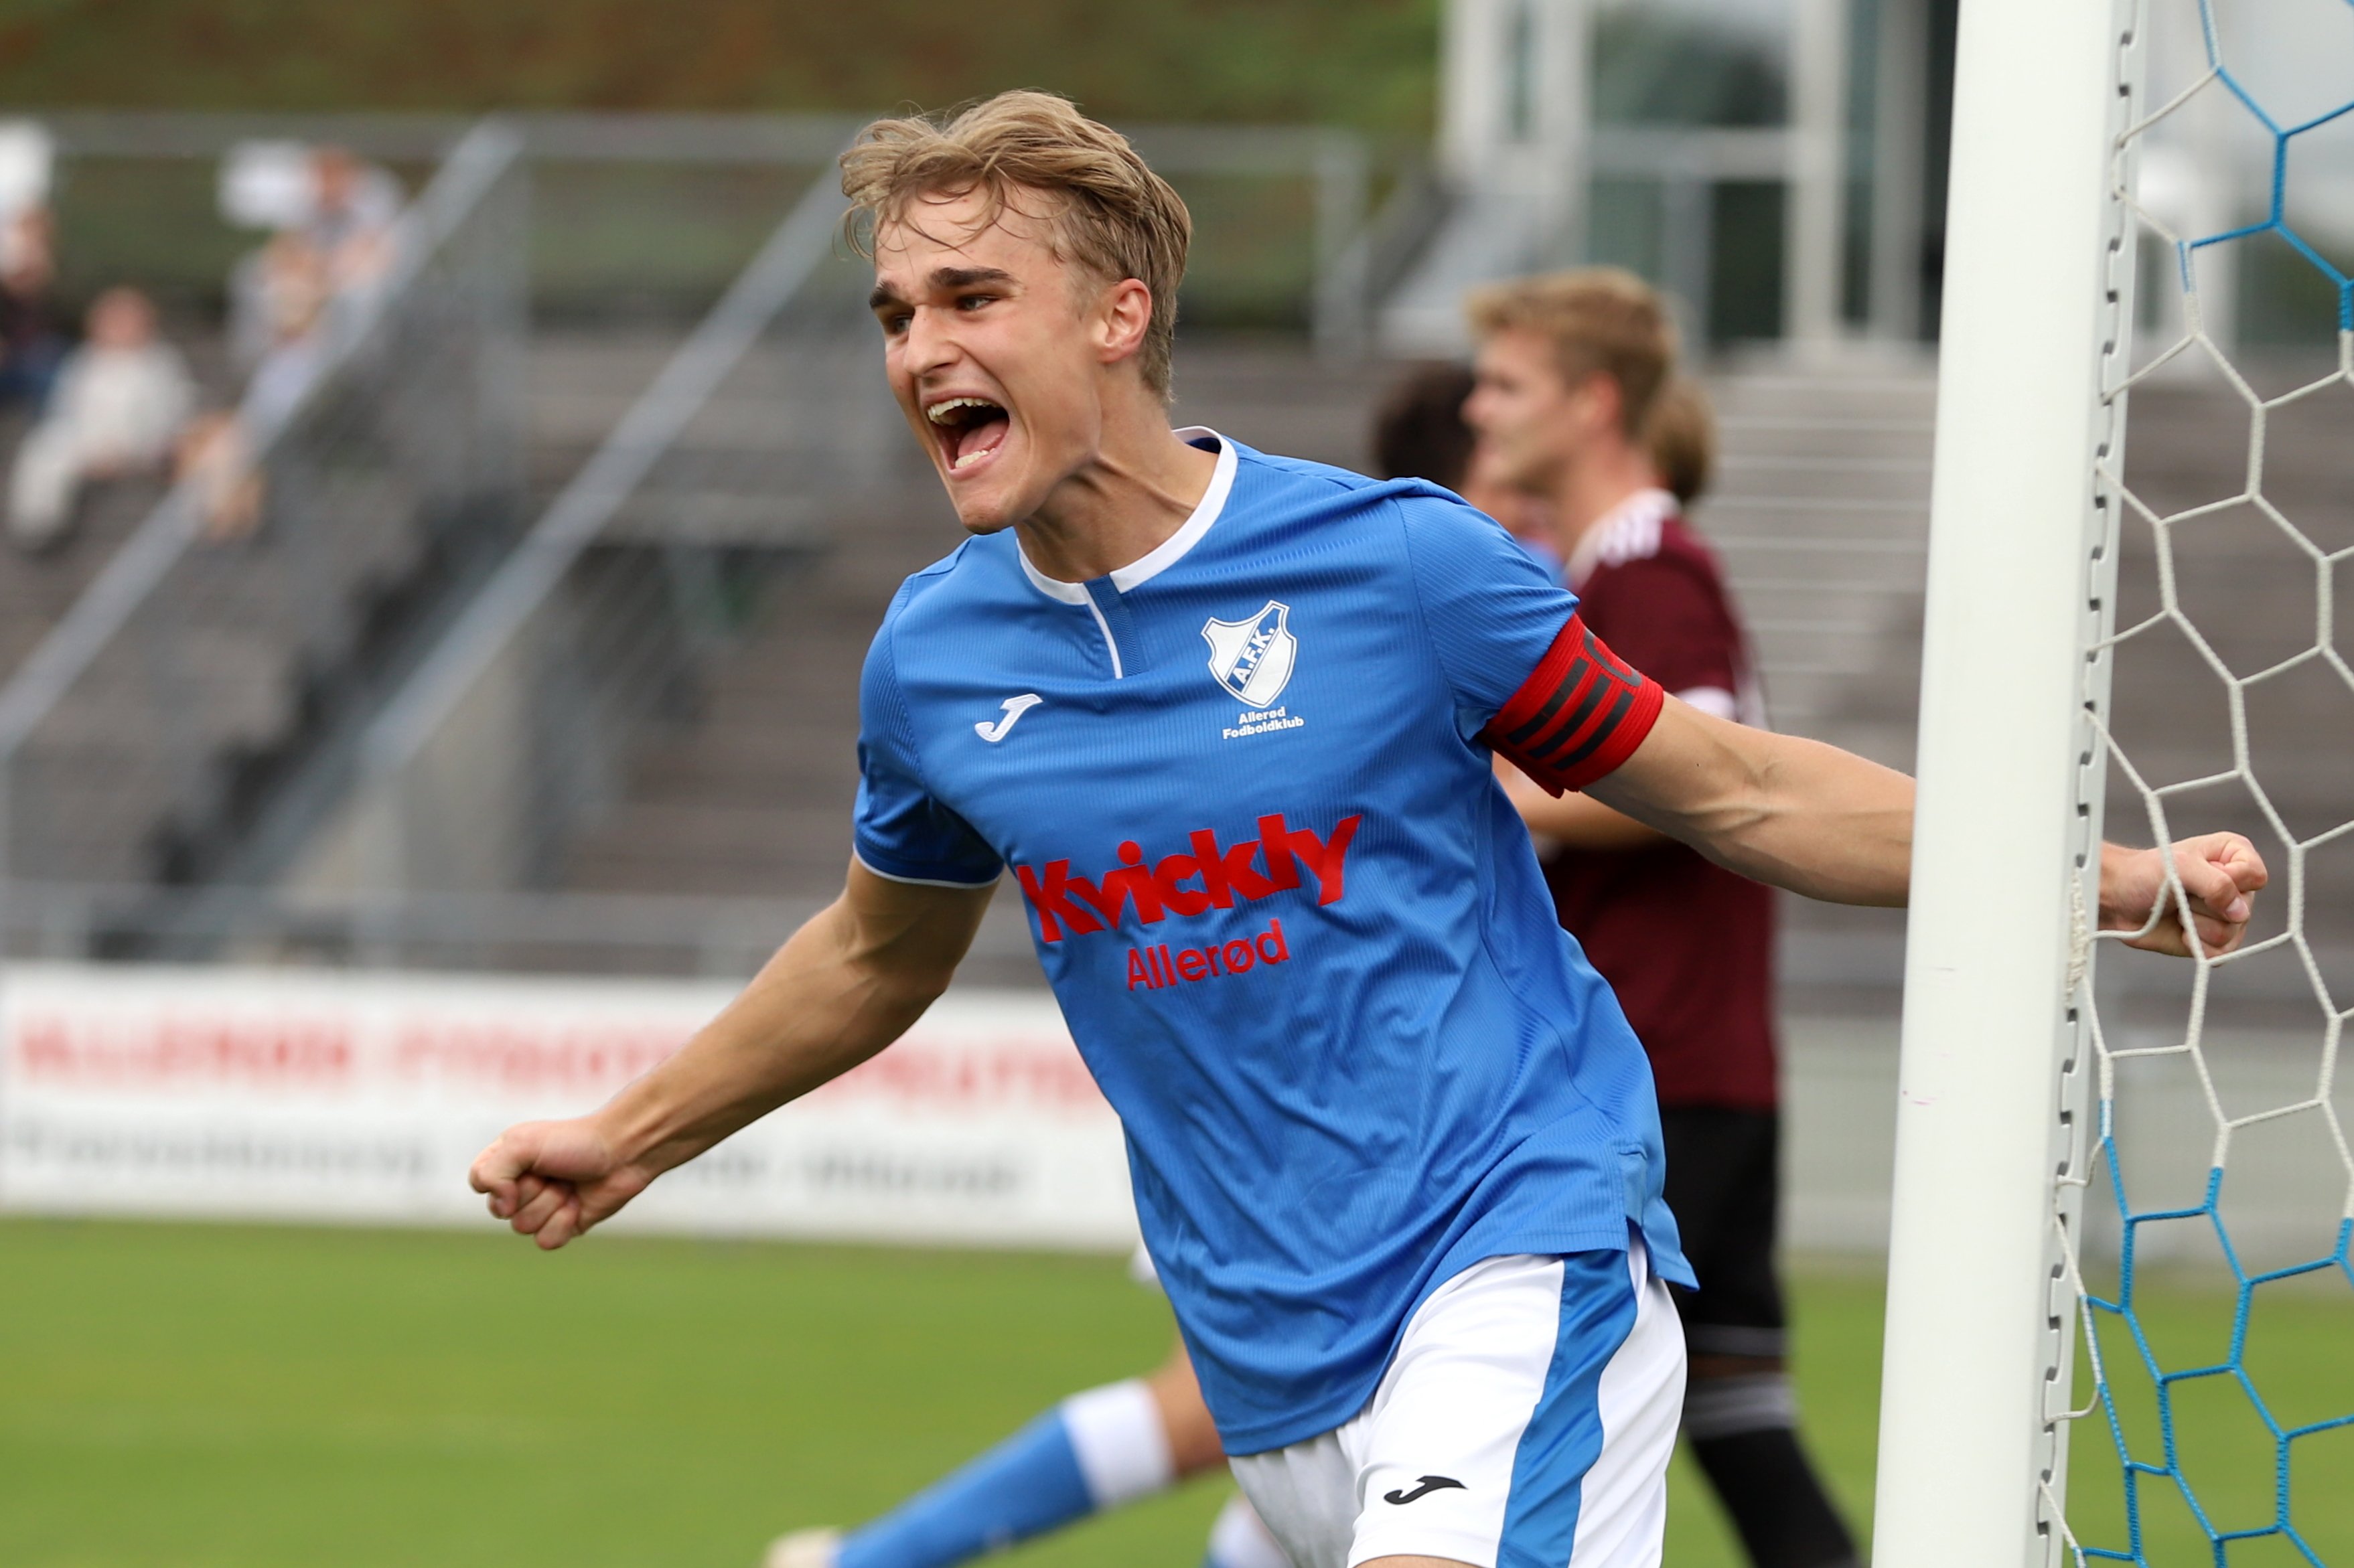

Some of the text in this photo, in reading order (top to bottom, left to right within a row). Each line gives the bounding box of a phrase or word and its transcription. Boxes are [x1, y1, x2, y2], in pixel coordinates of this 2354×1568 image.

[1232, 627, 1275, 684] A.F.K.
[1222, 716, 1305, 739] Fodboldklub
[1238, 706, 1286, 724] Allerød
[1016, 813, 1363, 943] Kvickly
[1126, 918, 1290, 991] Allerød
